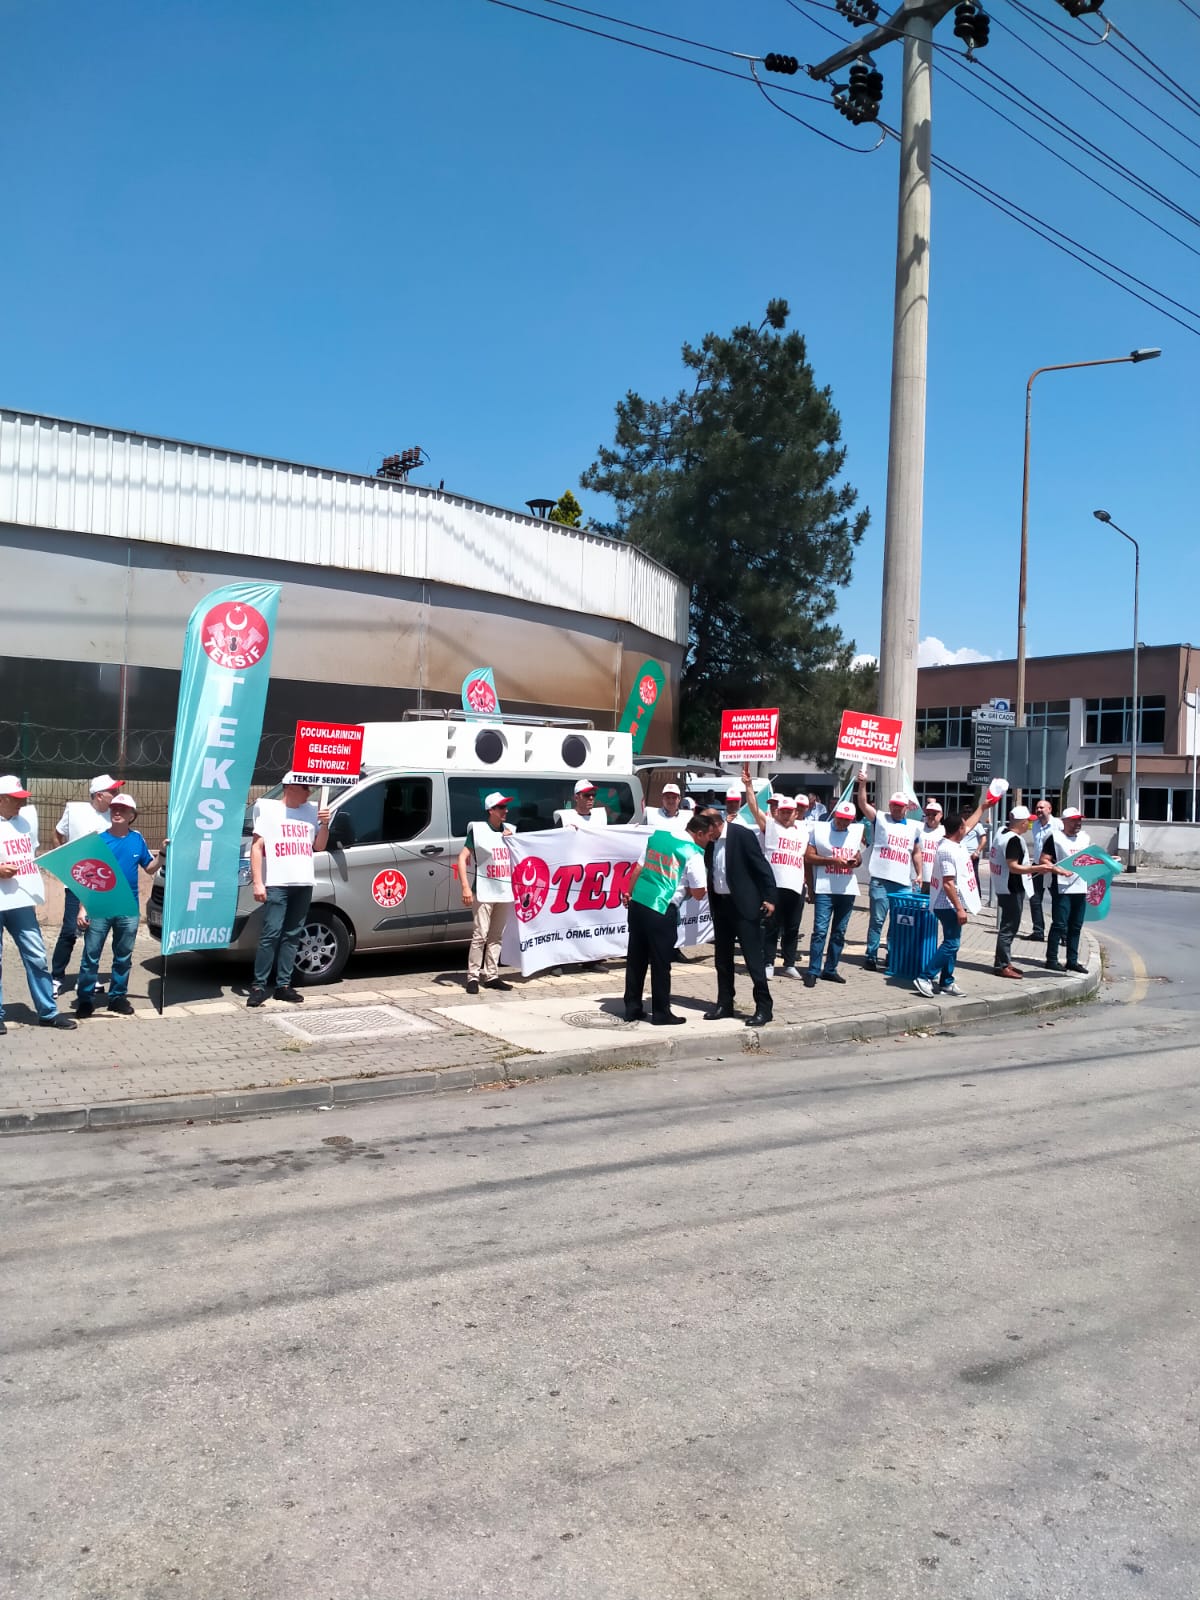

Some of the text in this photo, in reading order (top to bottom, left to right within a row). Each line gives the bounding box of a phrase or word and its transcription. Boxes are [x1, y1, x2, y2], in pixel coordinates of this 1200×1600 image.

[204, 637, 260, 667] TEKSİF
[860, 719, 880, 731] BİZ
[300, 727, 361, 740] ÇOCUKLARIMIZIN
[723, 730, 769, 739] KULLANMAK
[846, 727, 891, 742] BİRLİKTE
[308, 743, 352, 755] GELECEĞİNİ
[307, 757, 345, 770] İSTİYORUZ
[293, 775, 359, 785] TEKSİF SENDİKASI
[186, 675, 245, 912] TEKSİF
[281, 822, 309, 838] TEKSİF
[169, 923, 231, 948] SENDİKASI
[565, 928, 593, 940] ÖRME,
[616, 924, 627, 934] VE
